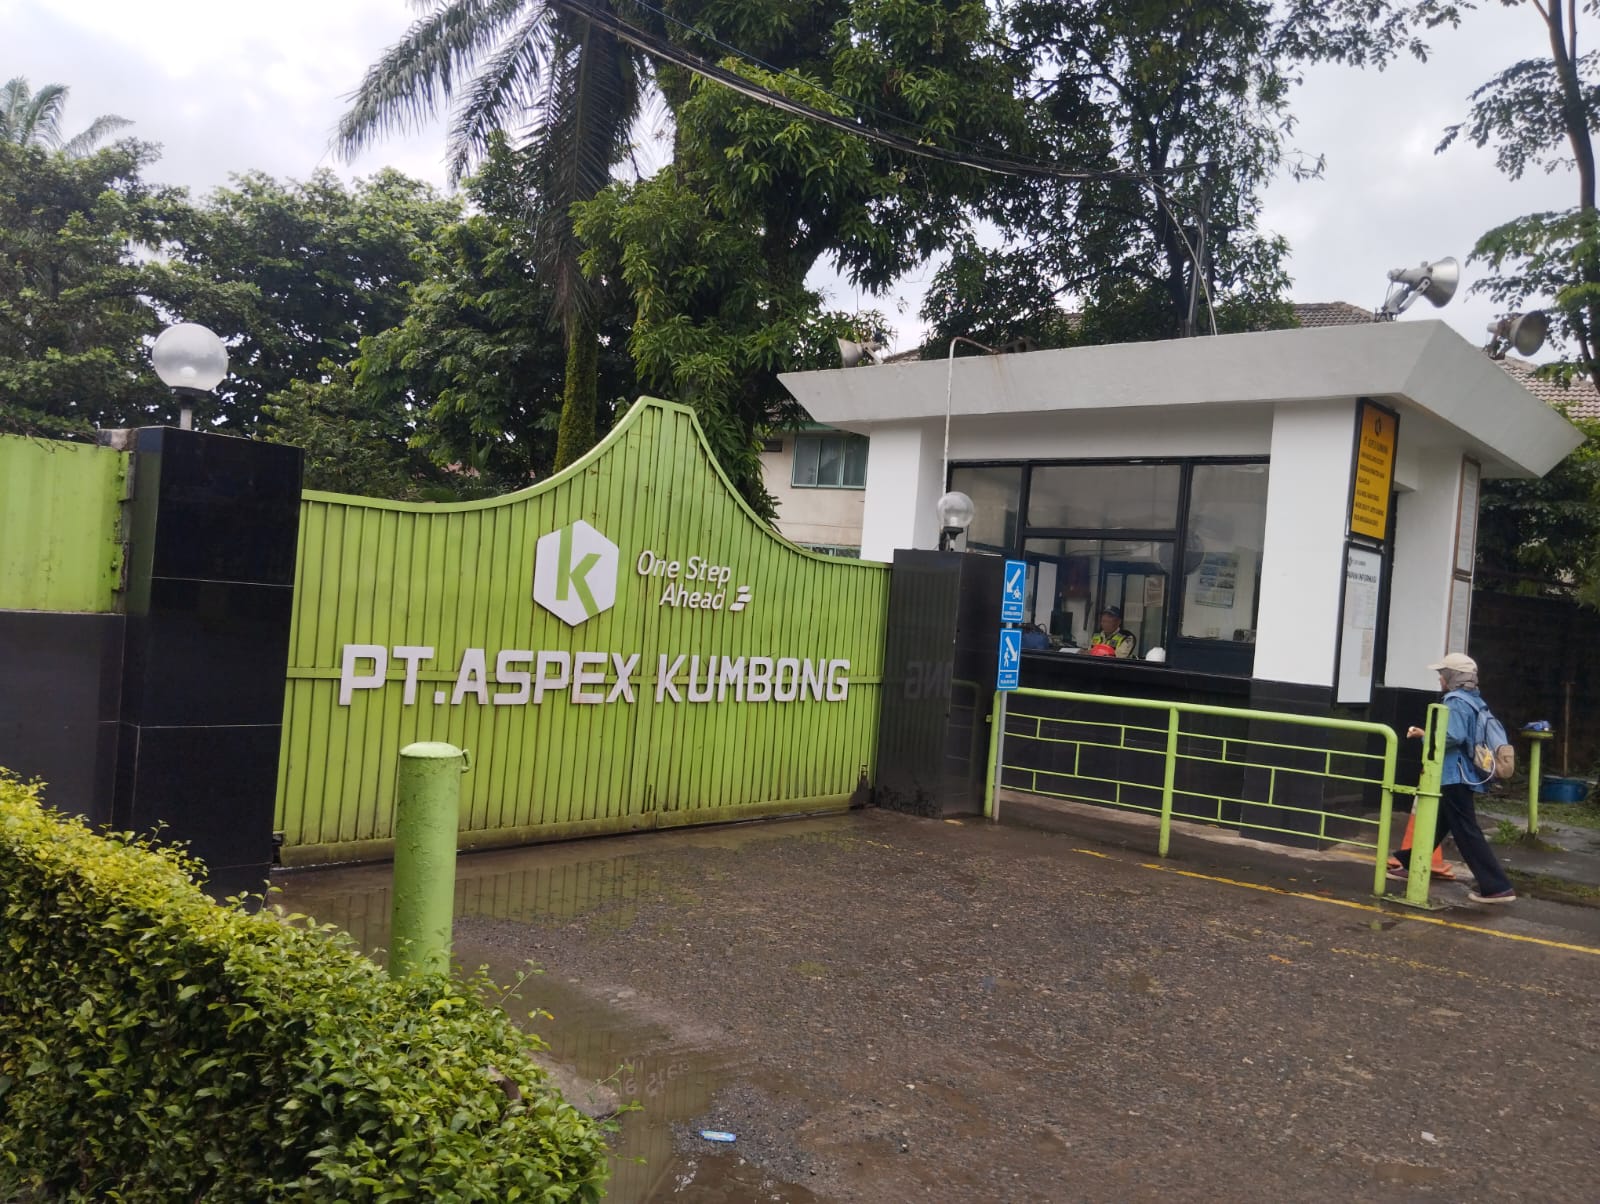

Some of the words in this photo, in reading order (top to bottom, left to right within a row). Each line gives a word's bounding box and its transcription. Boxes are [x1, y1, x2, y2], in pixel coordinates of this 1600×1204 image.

[636, 550, 681, 578] One
[685, 556, 732, 589] Step
[659, 582, 726, 610] Ahead
[338, 644, 641, 706] PT.ASPEX
[655, 652, 851, 703] KUMBONG
